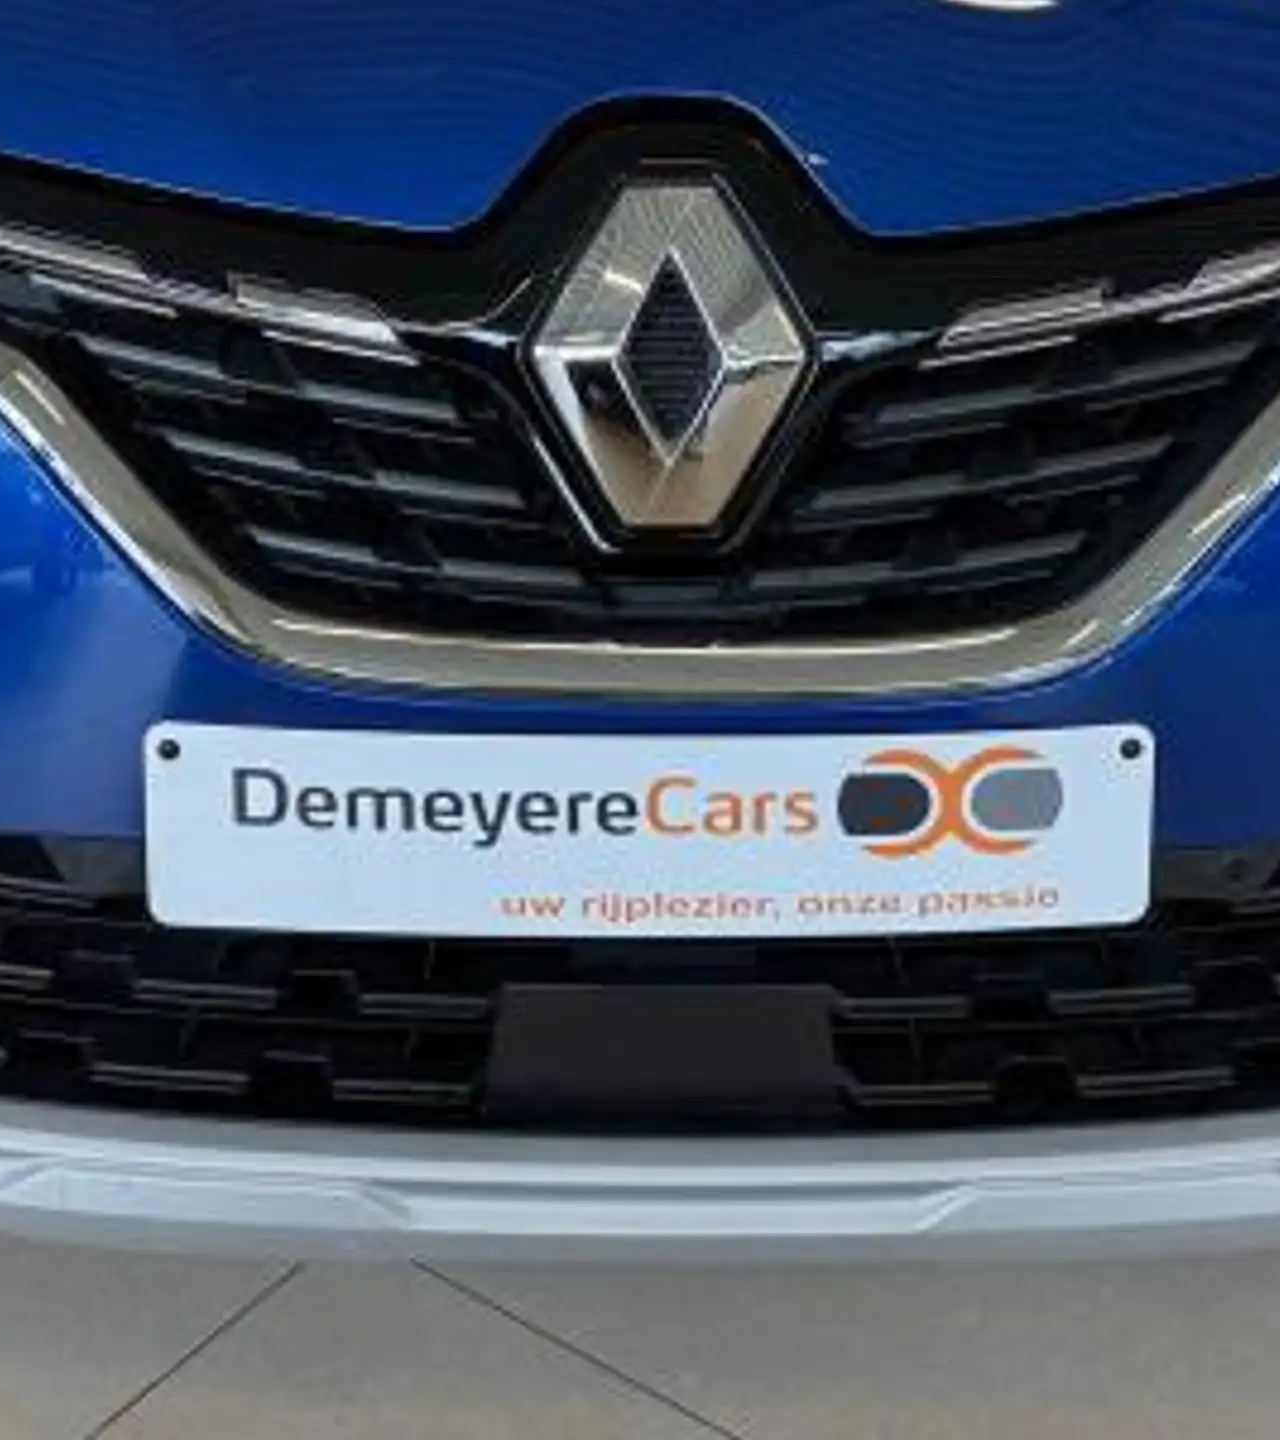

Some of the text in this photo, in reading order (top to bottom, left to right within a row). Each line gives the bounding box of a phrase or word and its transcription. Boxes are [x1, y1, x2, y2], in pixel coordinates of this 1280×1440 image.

[231, 766, 819, 846] DemeyereCars
[500, 895, 565, 918] uw
[797, 894, 901, 916] onze
[918, 887, 1060, 918] passie
